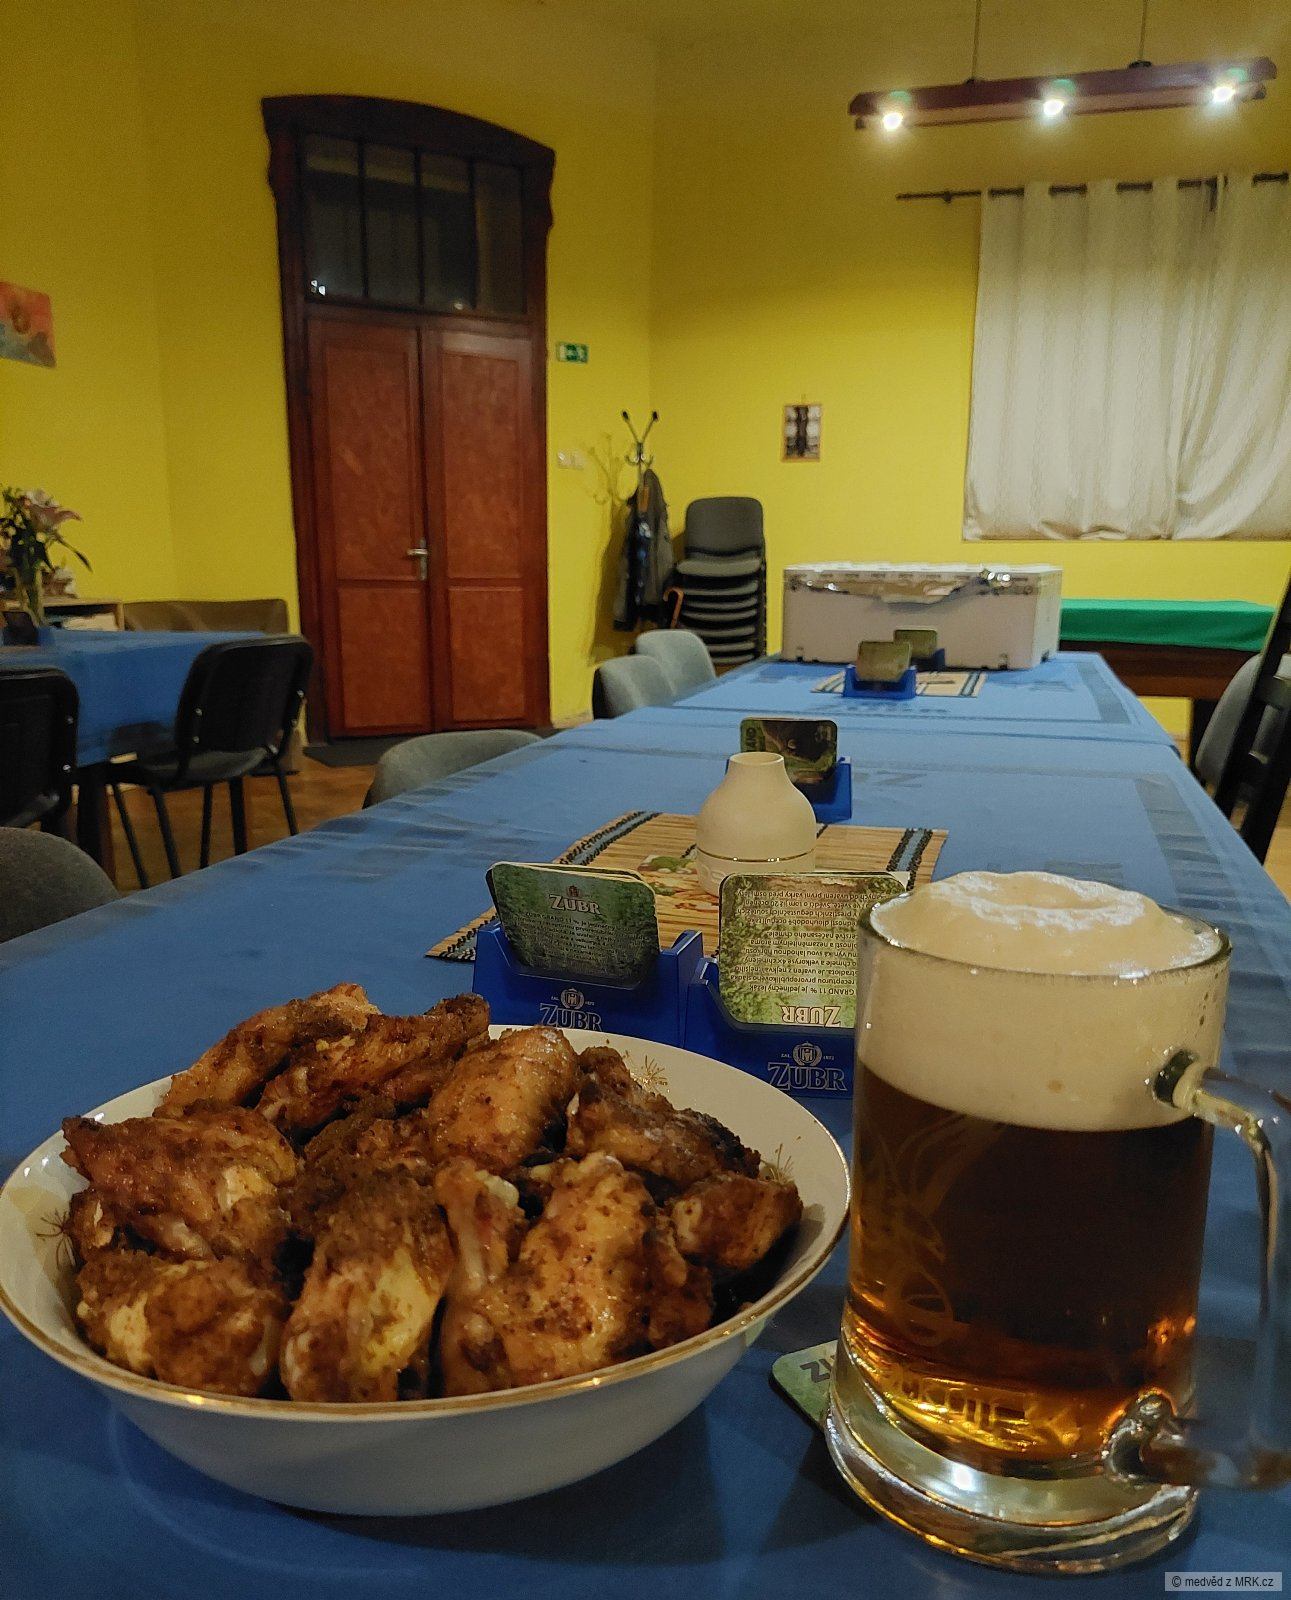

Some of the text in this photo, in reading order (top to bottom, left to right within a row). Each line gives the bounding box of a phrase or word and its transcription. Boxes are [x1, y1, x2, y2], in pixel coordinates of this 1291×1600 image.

[549, 894, 602, 914] ZUBR
[769, 909, 813, 917] degustačních
[766, 931, 792, 939] chmele.
[772, 940, 828, 948] nezaměnitelným
[774, 949, 805, 957] lahodnou
[753, 976, 816, 984] prvorepublikového
[768, 984, 800, 993] jedinečný
[539, 1002, 602, 1031] ZUBR
[780, 1005, 841, 1027] ZUBR
[767, 1062, 847, 1091] ZUBR
